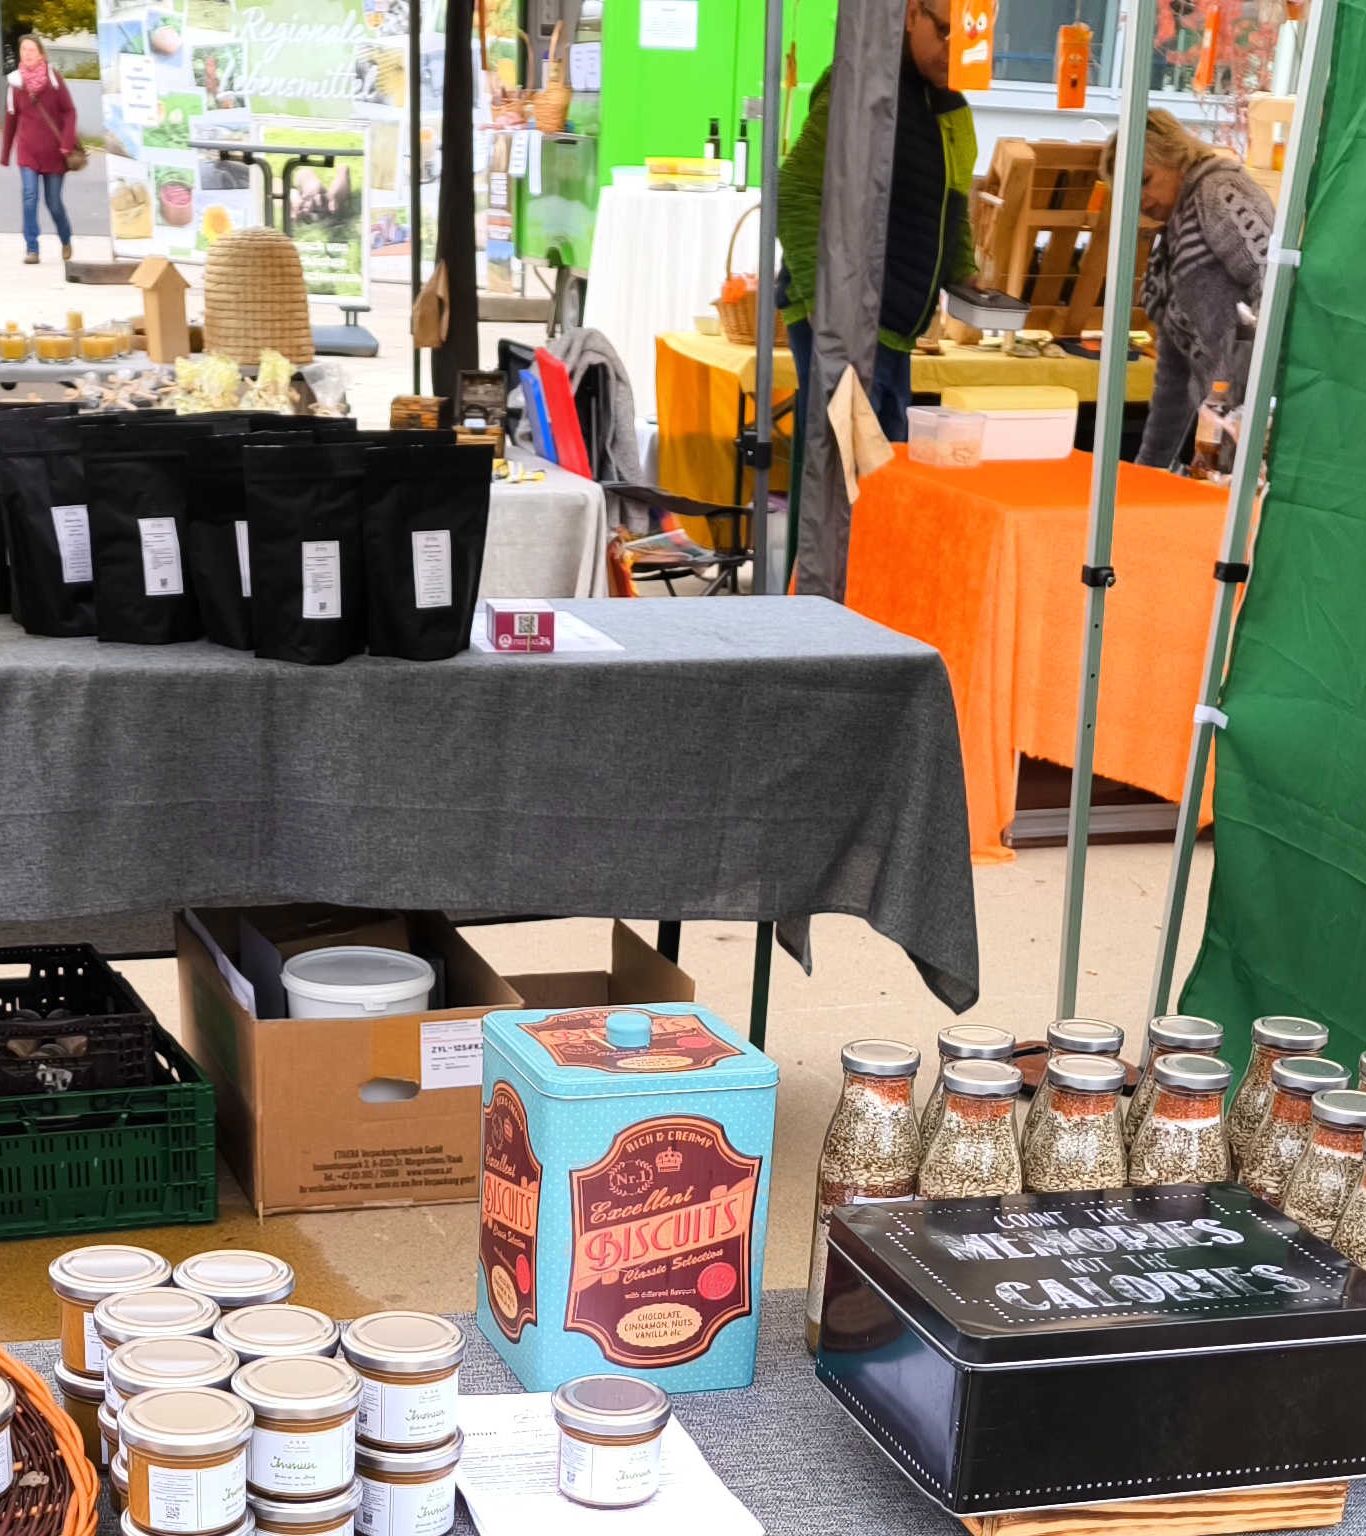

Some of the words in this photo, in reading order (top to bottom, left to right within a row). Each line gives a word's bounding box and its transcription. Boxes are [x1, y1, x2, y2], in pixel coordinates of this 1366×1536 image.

[240, 6, 367, 64] Regionale
[216, 57, 380, 101] Lebensmittel
[626, 1136, 653, 1153] RICH
[668, 1130, 713, 1148] CREAMY
[485, 1175, 532, 1230] BISCUITS
[590, 1185, 695, 1224] Excellent
[993, 1210, 1071, 1230] COUNT
[1085, 1206, 1137, 1223] THE
[585, 1201, 737, 1272] BISCUITS
[931, 1218, 1245, 1260] MEMORIES
[622, 1265, 667, 1285] Classic
[671, 1248, 724, 1271] Selection
[1061, 1256, 1115, 1274] NOT
[1122, 1252, 1181, 1270] THE
[994, 1264, 1312, 1311] CALORIES
[635, 1329, 668, 1340] VANILLA
[270, 1455, 318, 1470] Immun
